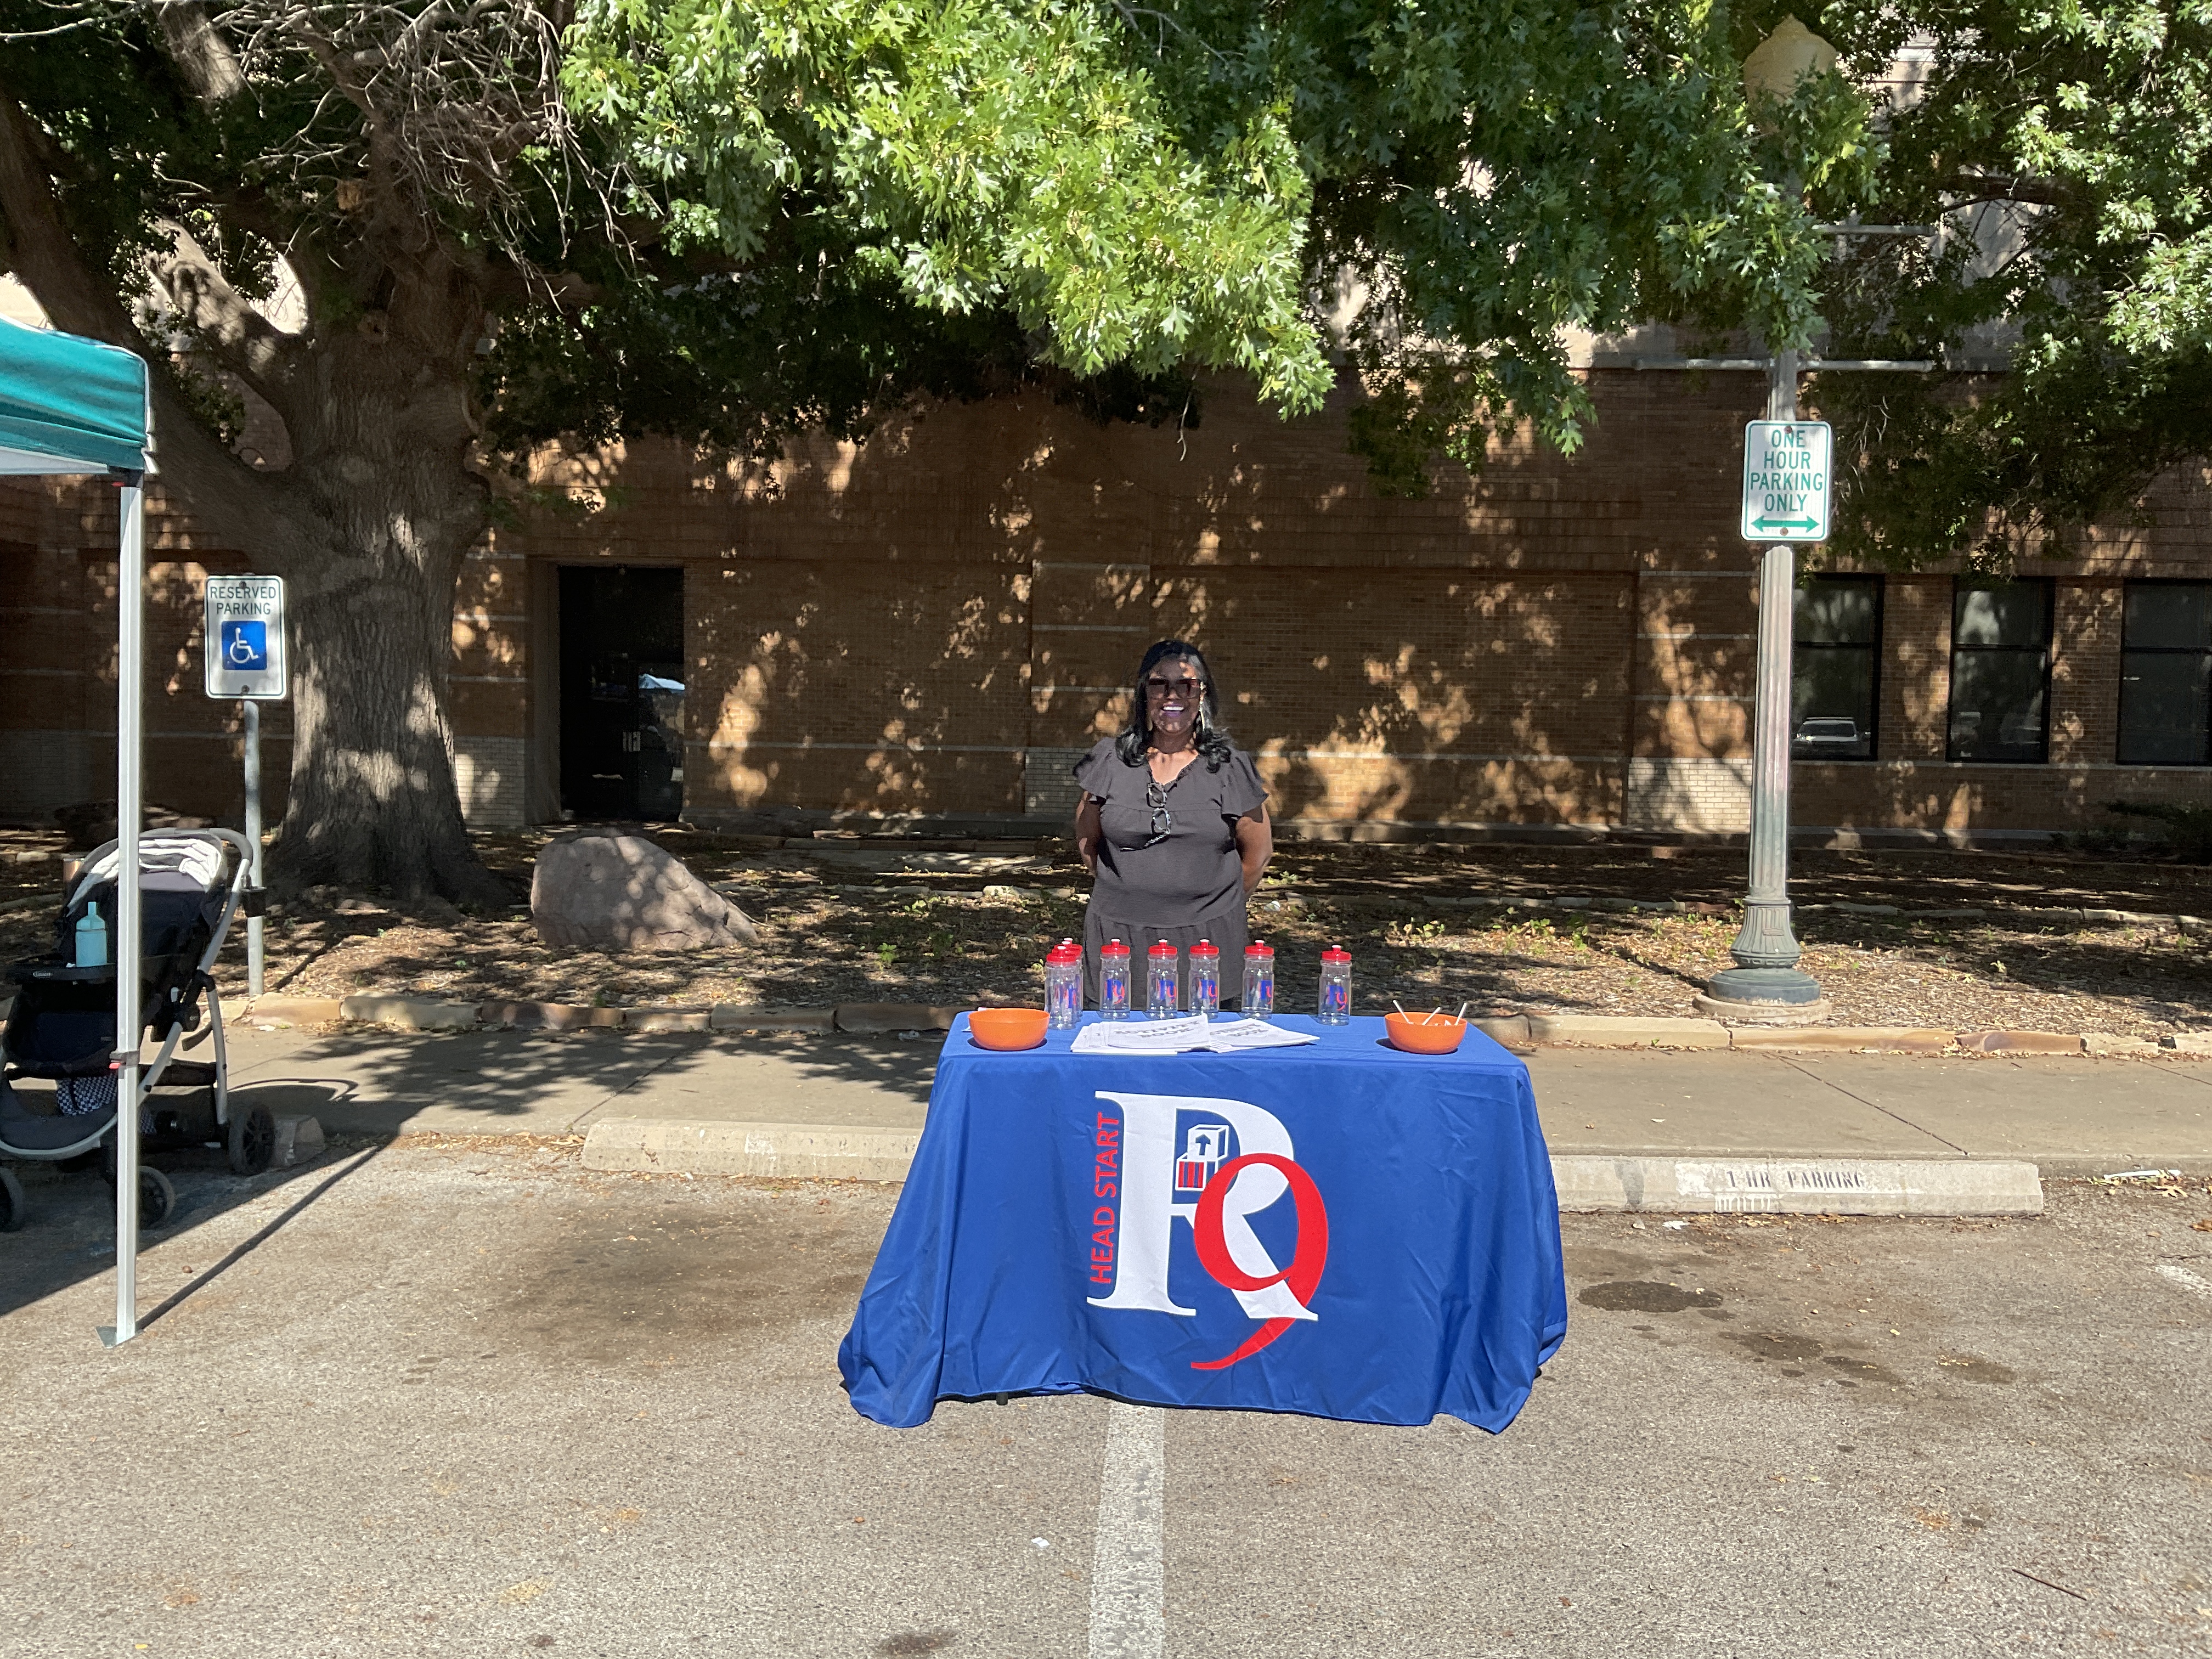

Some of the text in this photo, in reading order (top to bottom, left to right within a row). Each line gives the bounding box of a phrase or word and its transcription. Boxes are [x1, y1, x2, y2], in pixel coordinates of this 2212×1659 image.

[1771, 430, 1805, 448] ONE
[1764, 450, 1812, 470] HOUR
[1750, 472, 1823, 491] PARKING
[1764, 493, 1808, 512] ONLY
[210, 586, 276, 599] RESERVED
[216, 603, 271, 615] PARKING
[1138, 1028, 1194, 1038] BOOK
[1726, 1171, 1865, 1188] 1 HR PARKING
[1090, 1111, 1120, 1284] HEAD START
